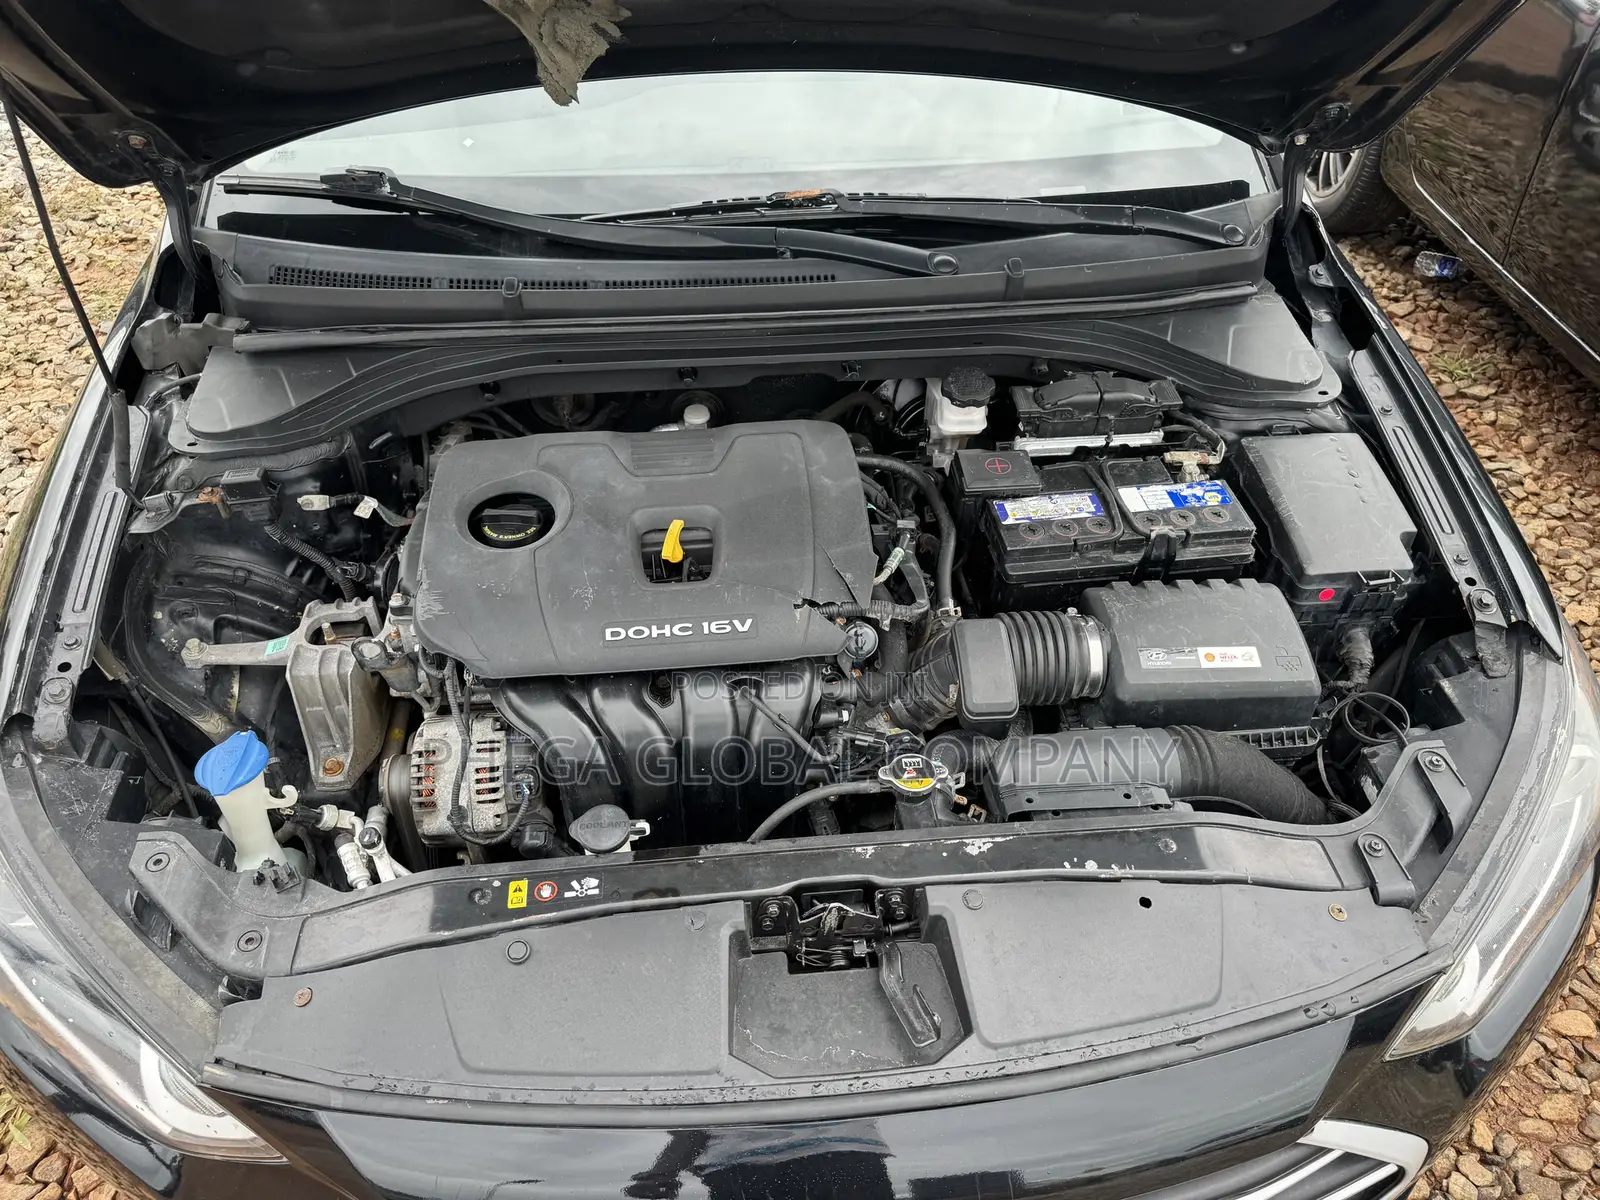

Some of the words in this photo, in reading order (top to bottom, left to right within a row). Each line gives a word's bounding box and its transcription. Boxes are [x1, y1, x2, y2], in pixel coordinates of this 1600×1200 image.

[604, 621, 695, 642] DOHC
[702, 617, 753, 635] 16V
[579, 819, 629, 831] COOLANT
